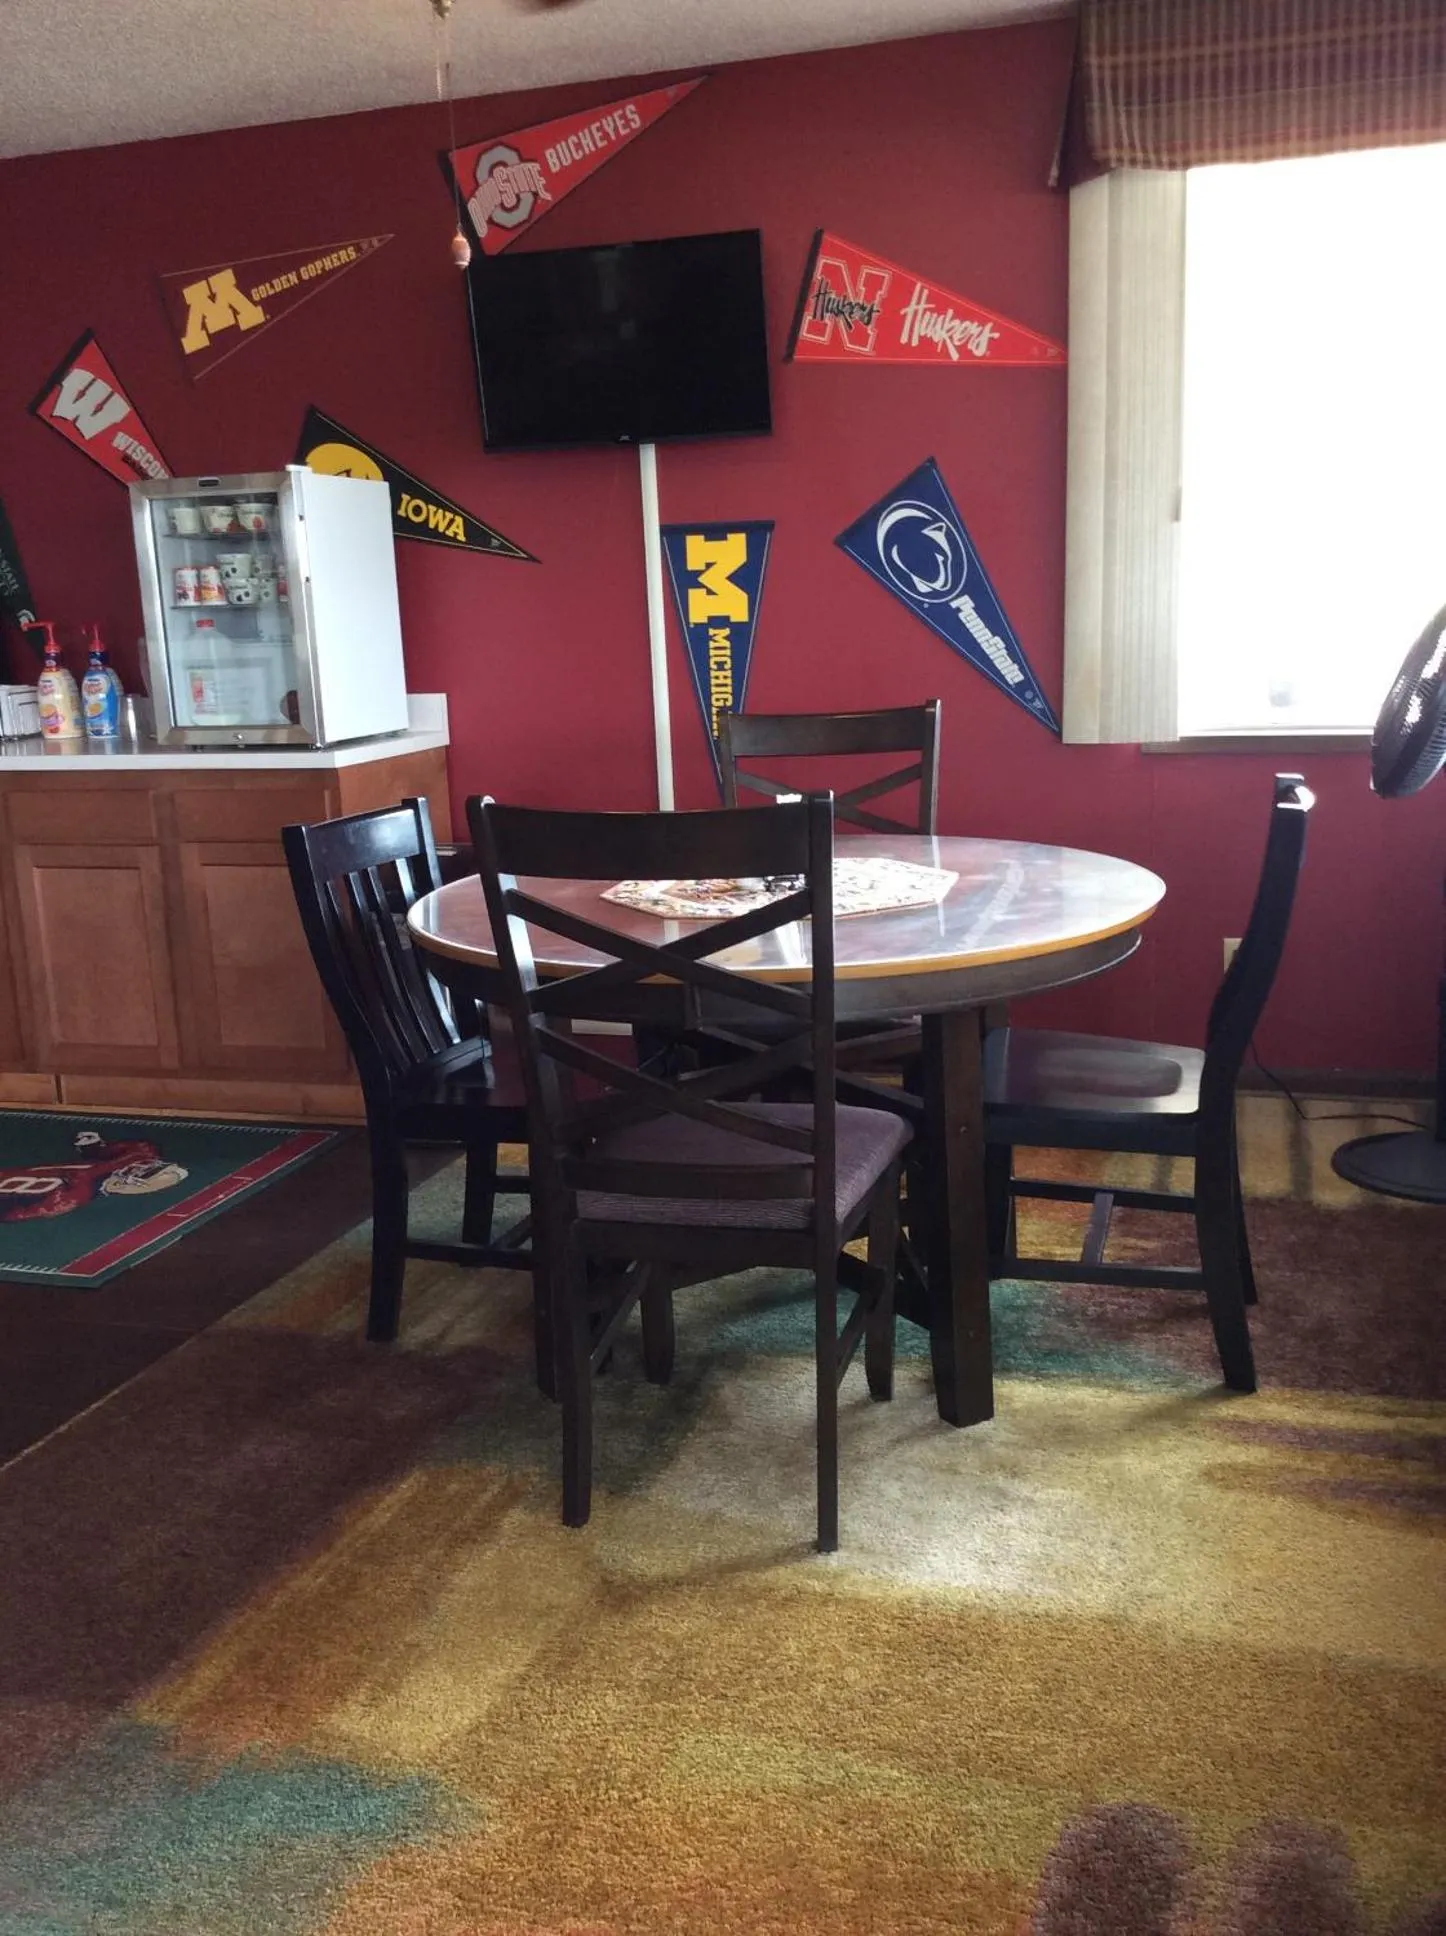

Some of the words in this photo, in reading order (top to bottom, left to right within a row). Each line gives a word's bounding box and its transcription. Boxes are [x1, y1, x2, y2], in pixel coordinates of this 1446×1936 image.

[251, 270, 300, 302] GOLDEN
[300, 246, 358, 281] GOPHERS
[811, 275, 880, 331] Huskers
[179, 268, 265, 355] M
[900, 281, 1000, 361] Huskers
[52, 367, 131, 441] W
[397, 493, 467, 543] IOWA
[685, 532, 749, 624] M
